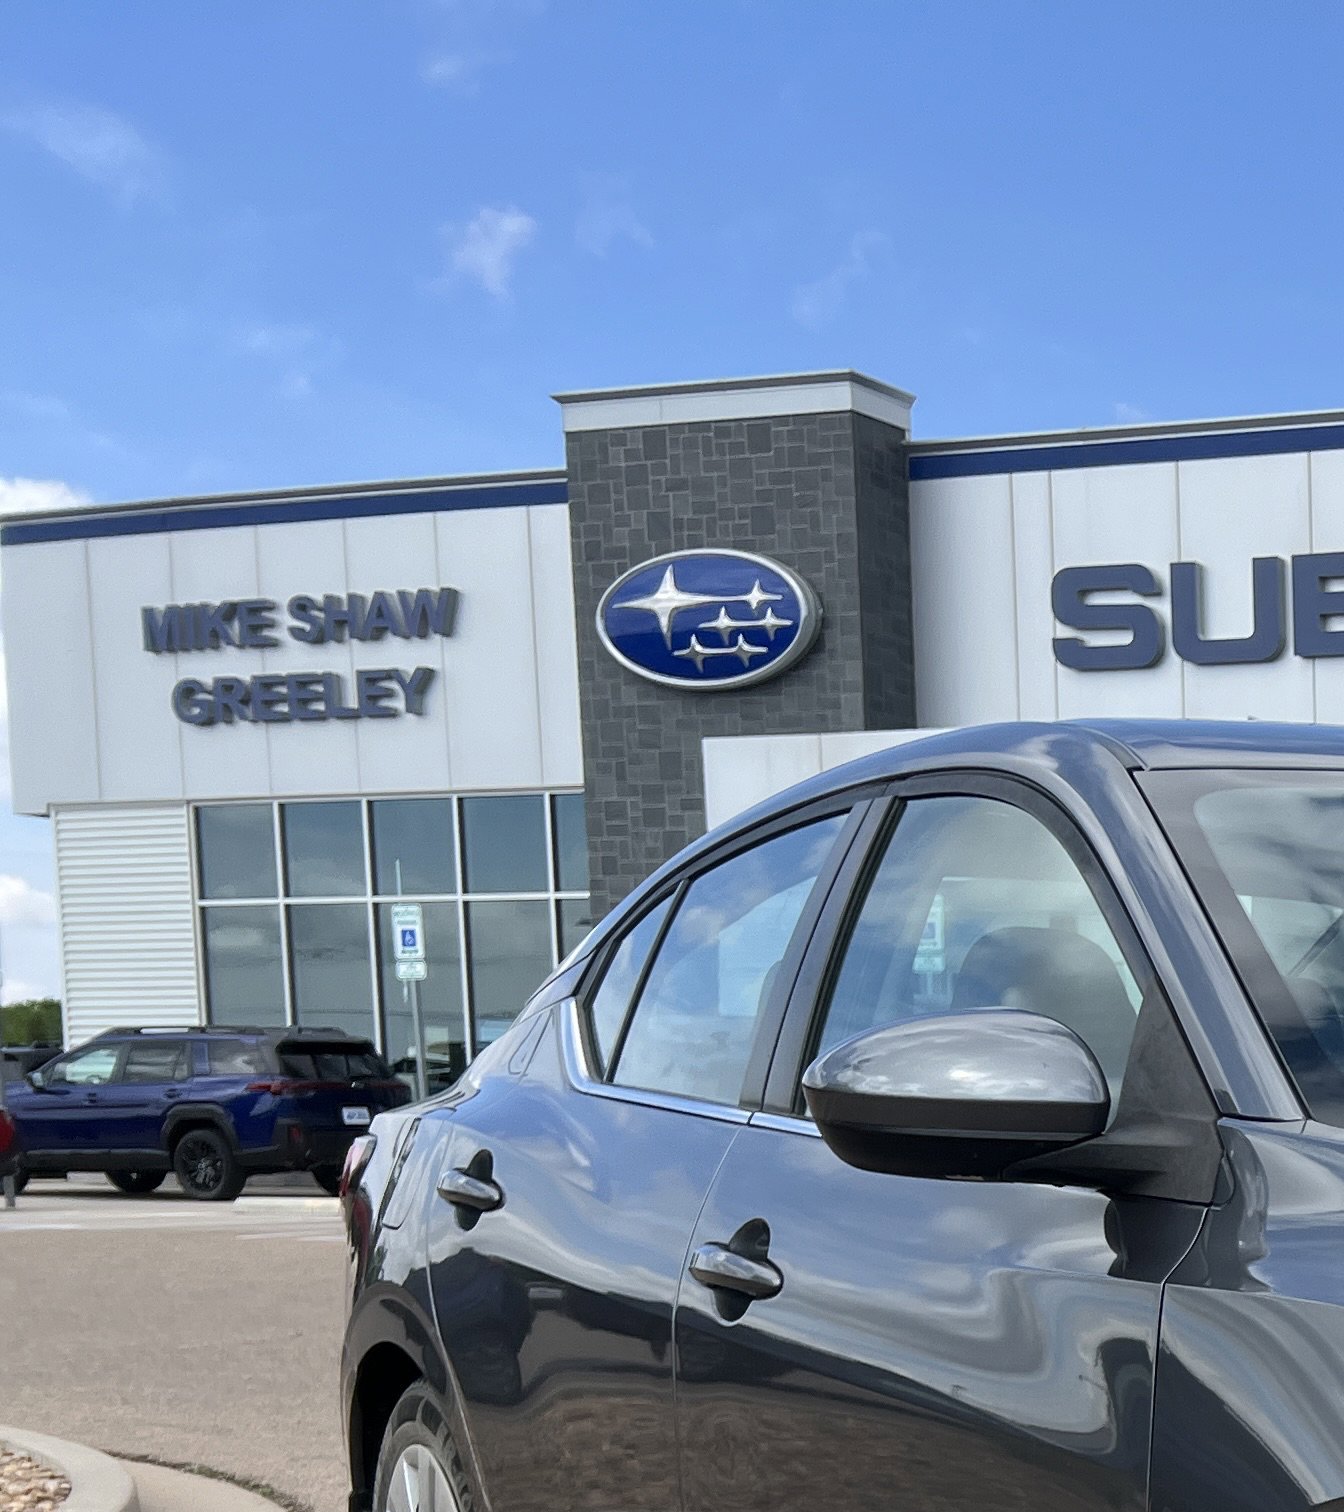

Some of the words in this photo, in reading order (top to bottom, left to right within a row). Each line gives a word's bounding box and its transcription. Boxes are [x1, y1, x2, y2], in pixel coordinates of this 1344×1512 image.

[142, 598, 279, 655] MIKE
[286, 586, 461, 645] SHAW
[172, 665, 436, 726] GREELEY
